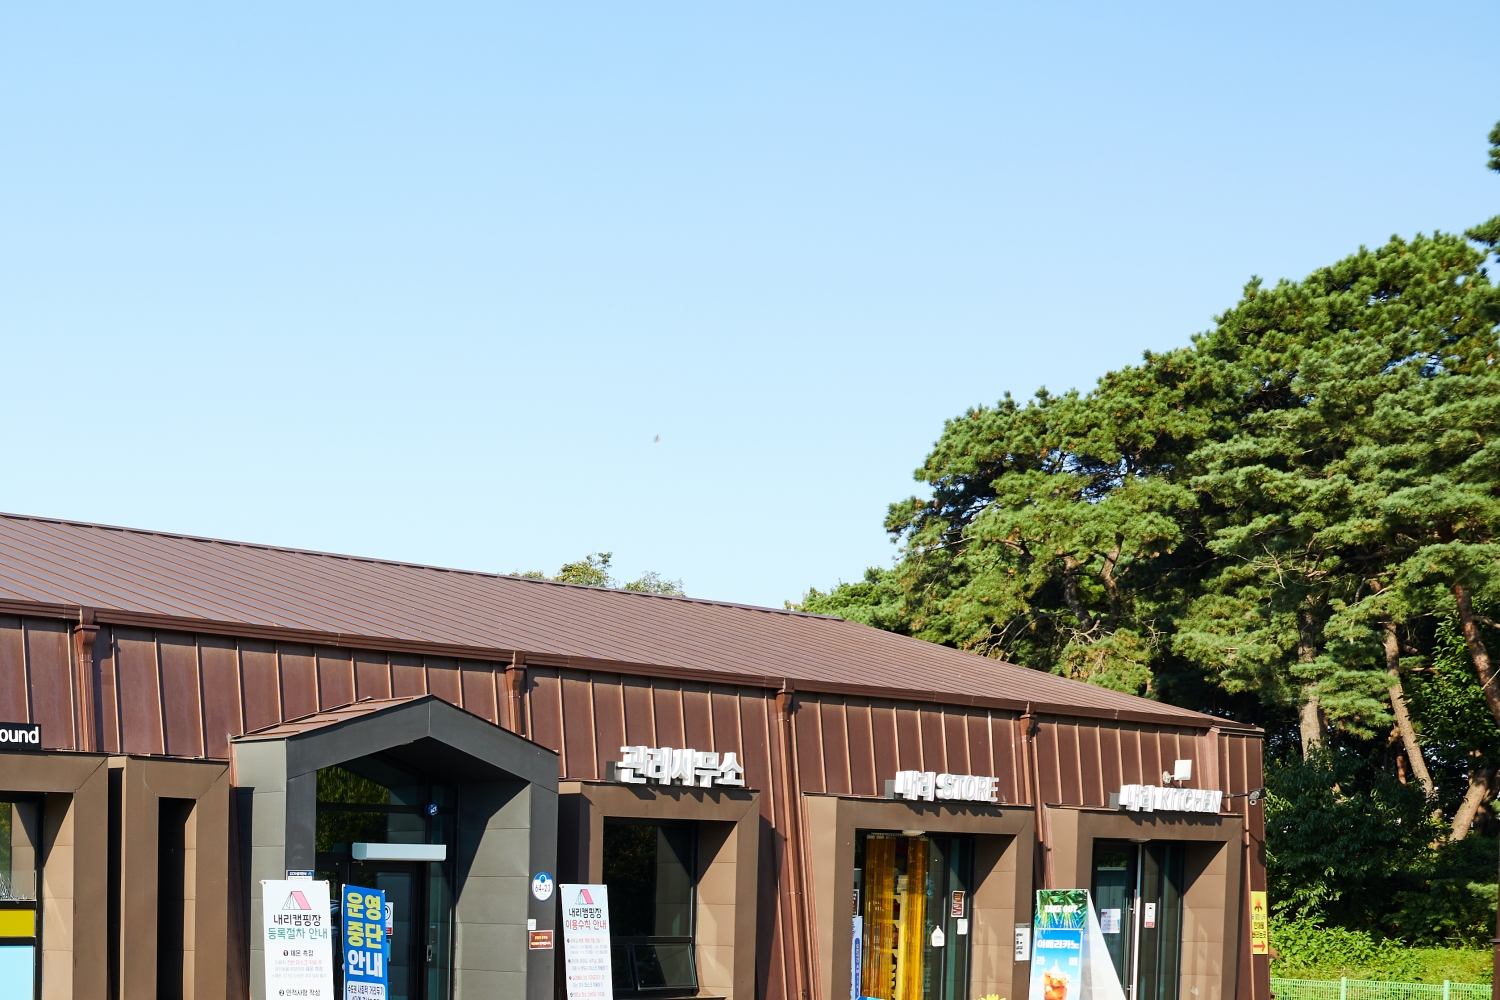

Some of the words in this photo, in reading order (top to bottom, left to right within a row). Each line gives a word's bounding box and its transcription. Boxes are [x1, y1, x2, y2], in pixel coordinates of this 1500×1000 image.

[618, 746, 744, 788] 관리사무소
[936, 774, 999, 802] STORE
[1156, 787, 1222, 813] KITCHEN
[347, 892, 382, 920] 운영
[568, 908, 602, 918] 내리캠핑장
[1044, 905, 1062, 913] TAKE
[1063, 905, 1078, 913] OUT
[273, 914, 321, 926] 내리캠핑장
[566, 920, 591, 930] 이용수칙
[593, 920, 607, 929] 안내
[268, 928, 306, 940] 등록절차
[308, 928, 328, 940] 안내
[347, 921, 383, 949] 중단
[1037, 940, 1080, 949] 아메리카노
[347, 950, 383, 977] 안내
